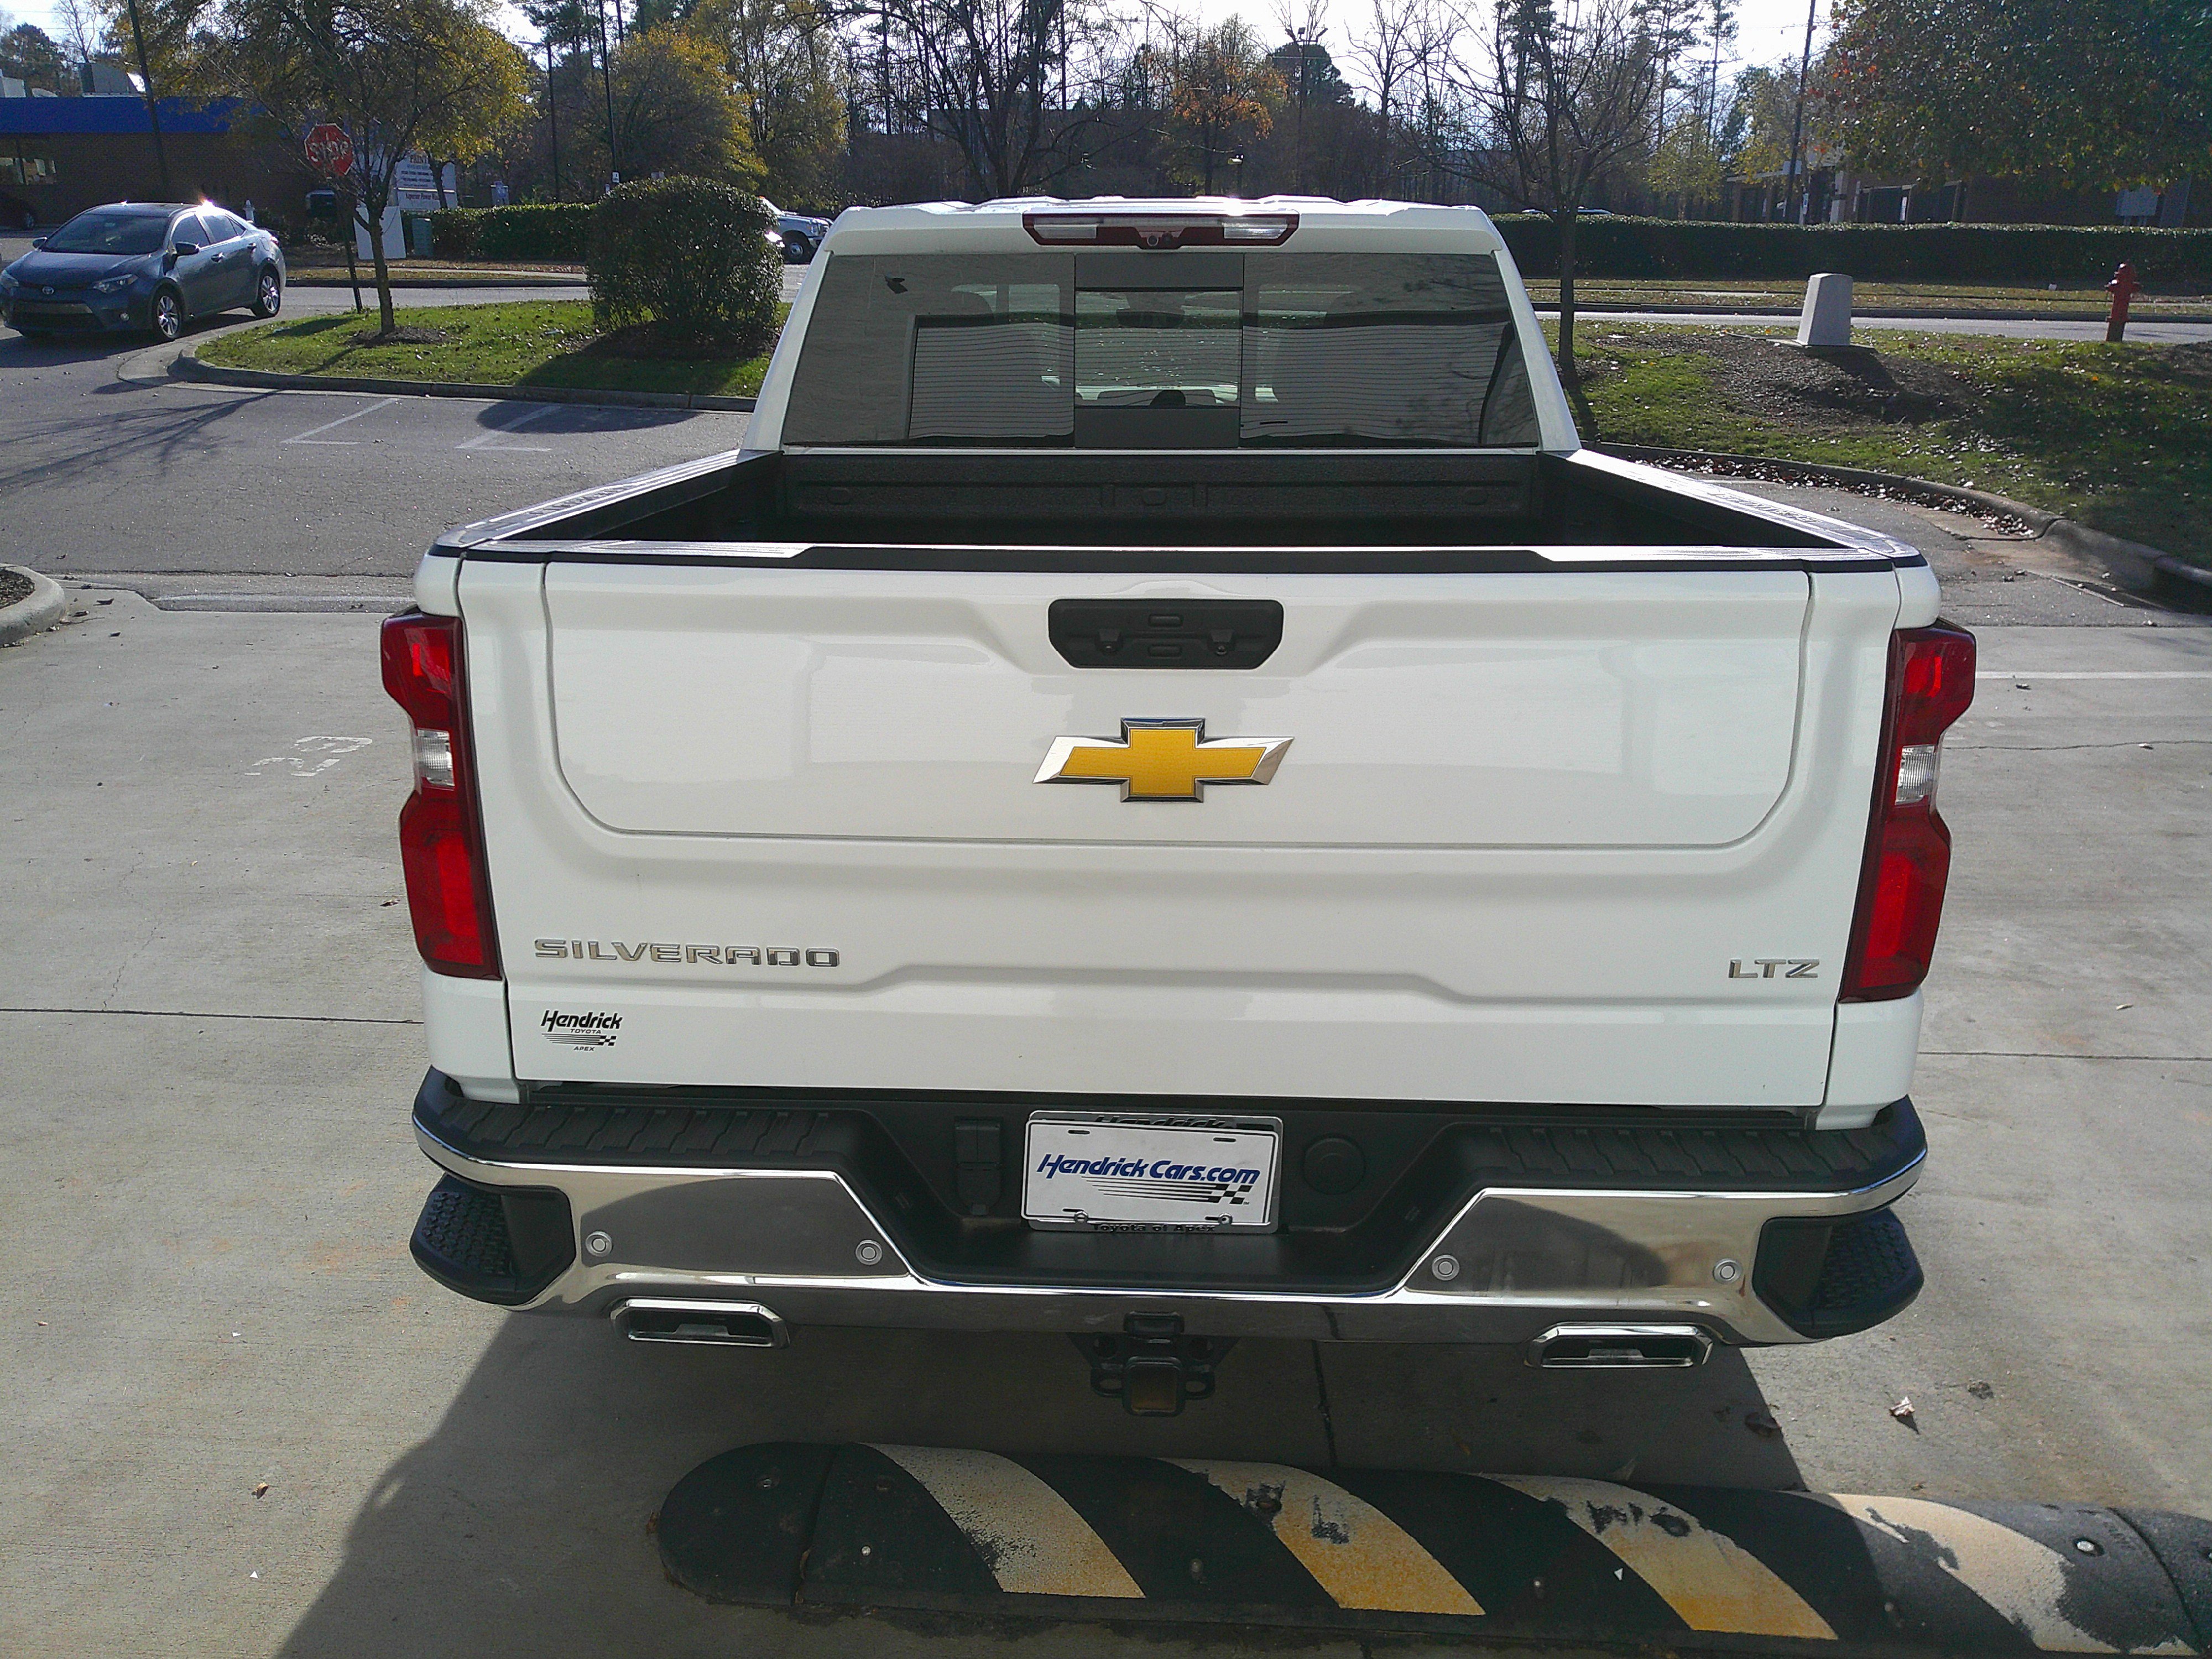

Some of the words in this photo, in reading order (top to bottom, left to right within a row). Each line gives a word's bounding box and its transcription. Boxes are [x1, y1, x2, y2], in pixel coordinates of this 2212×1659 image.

[534, 938, 839, 967] SILVERADO
[1728, 959, 1820, 978] LTZ
[540, 1010, 623, 1032] Hendrick
[1093, 1223, 1146, 1232] Toyota
[1152, 1223, 1168, 1232] of
[1173, 1224, 1217, 1232] Apex
